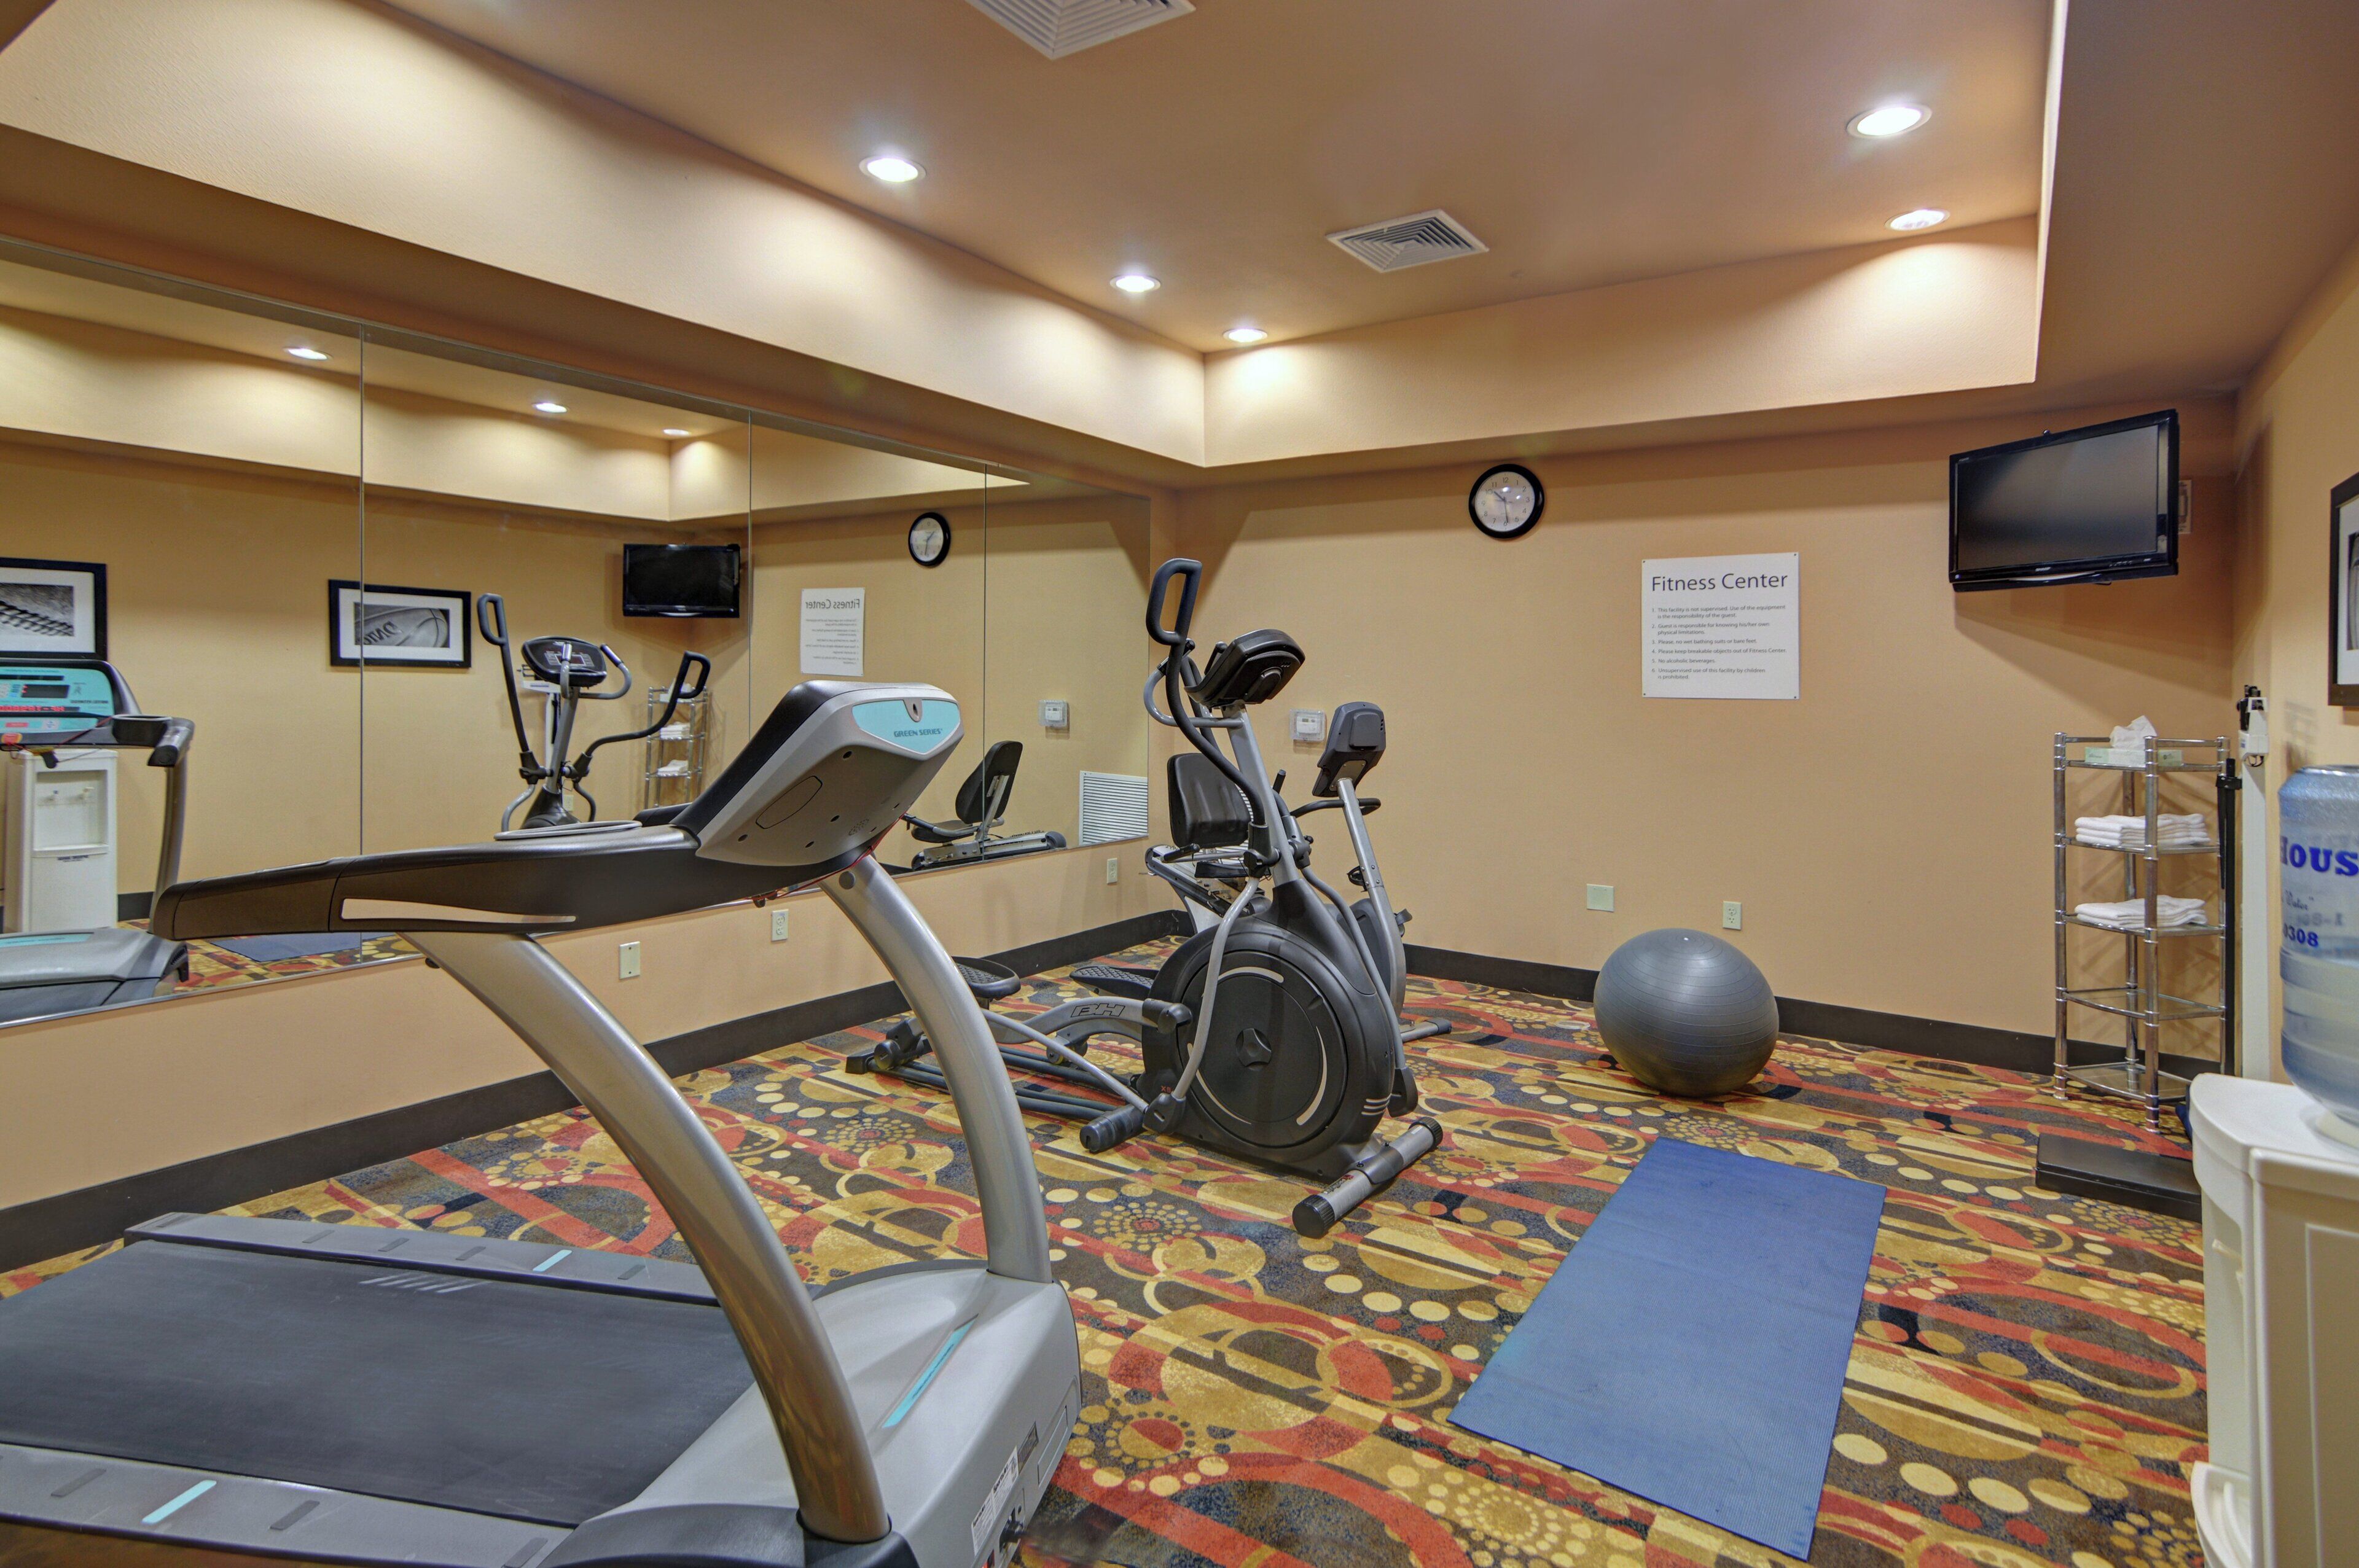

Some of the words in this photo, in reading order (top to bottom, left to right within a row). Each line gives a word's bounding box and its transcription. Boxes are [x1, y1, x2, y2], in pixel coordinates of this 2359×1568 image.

[1652, 576, 1716, 591] Fitness
[1722, 573, 1788, 589] Center
[1071, 1003, 1125, 1018] BH
